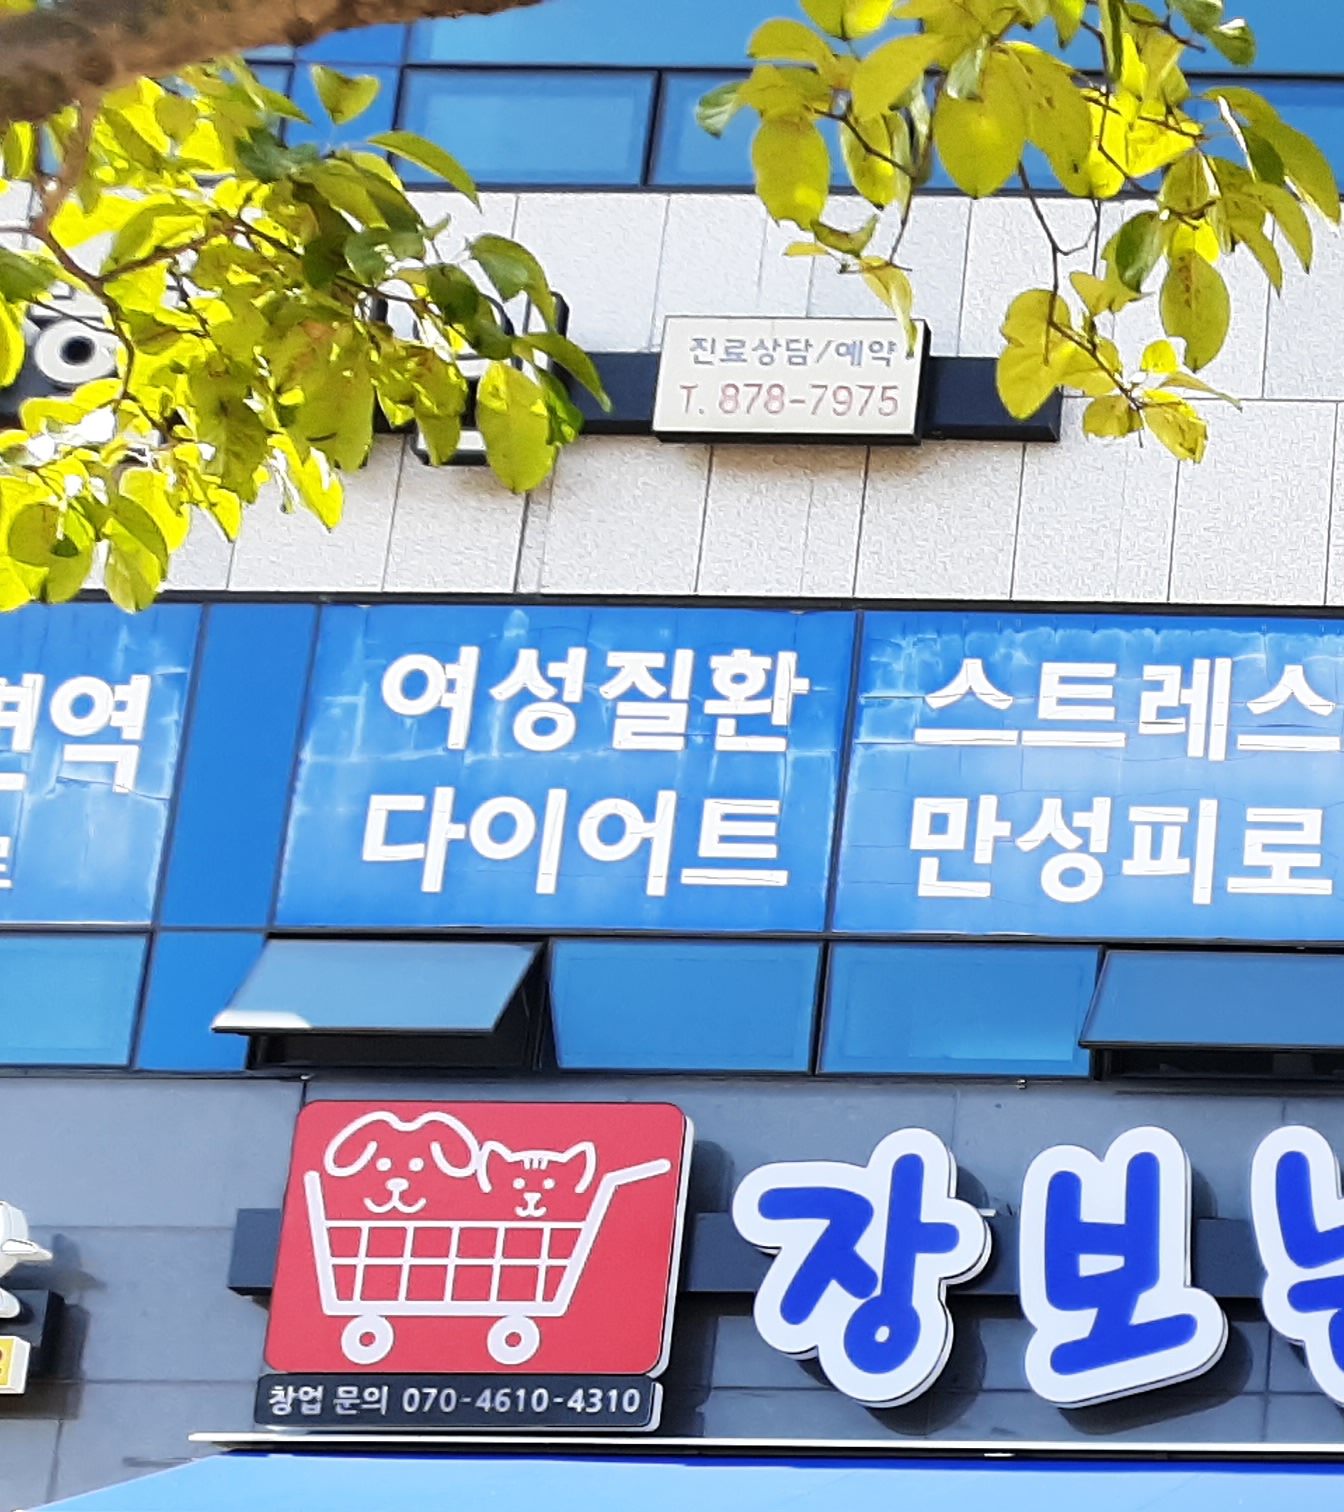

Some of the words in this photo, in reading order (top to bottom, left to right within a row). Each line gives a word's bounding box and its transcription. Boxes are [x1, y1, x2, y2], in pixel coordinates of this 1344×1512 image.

[689, 337, 897, 367] 진료상담/예약
[718, 384, 899, 416] 878-7975
[381, 645, 810, 752] 여성질환
[914, 658, 1341, 761] 스트레스
[362, 786, 789, 897] 다이어트
[909, 795, 1333, 905] 만성피로
[269, 1385, 324, 1416] 창업
[333, 1385, 389, 1416] 문의
[402, 1387, 641, 1414] 070-4610-4310
